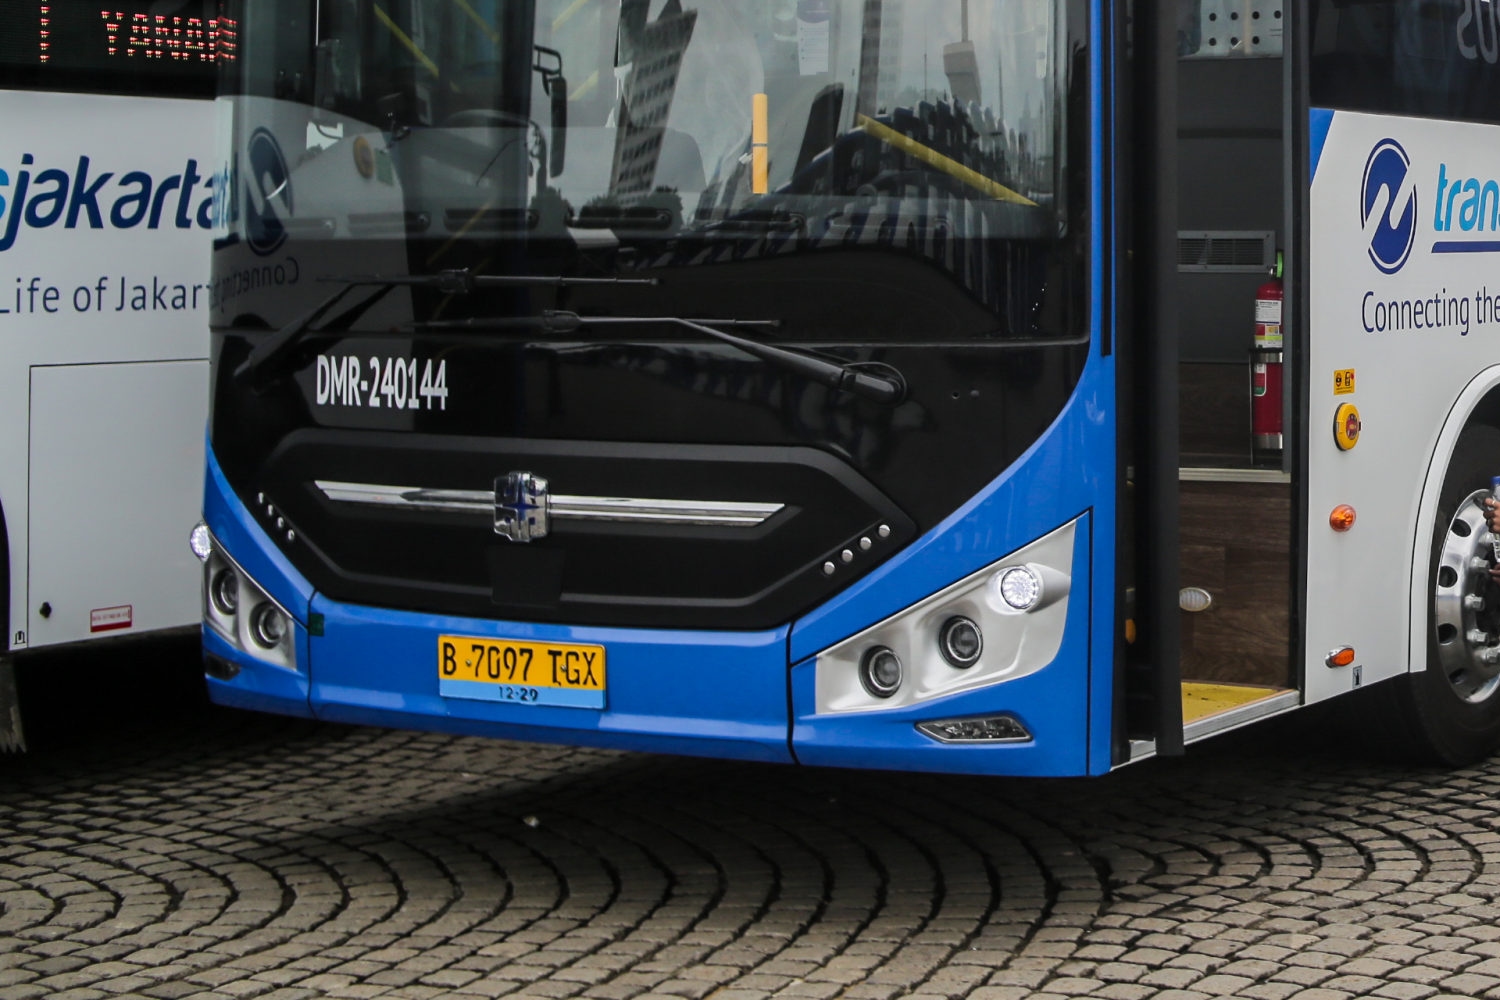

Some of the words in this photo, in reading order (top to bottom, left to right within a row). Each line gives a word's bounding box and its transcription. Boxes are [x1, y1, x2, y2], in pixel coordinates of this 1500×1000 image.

[72, 276, 107, 312] of
[115, 276, 212, 312] Jakar
[1361, 287, 1470, 336] Connecting
[316, 354, 449, 411] DMR-240144
[443, 642, 457, 676] B
[471, 644, 534, 682] 7097
[547, 649, 599, 687] TGX
